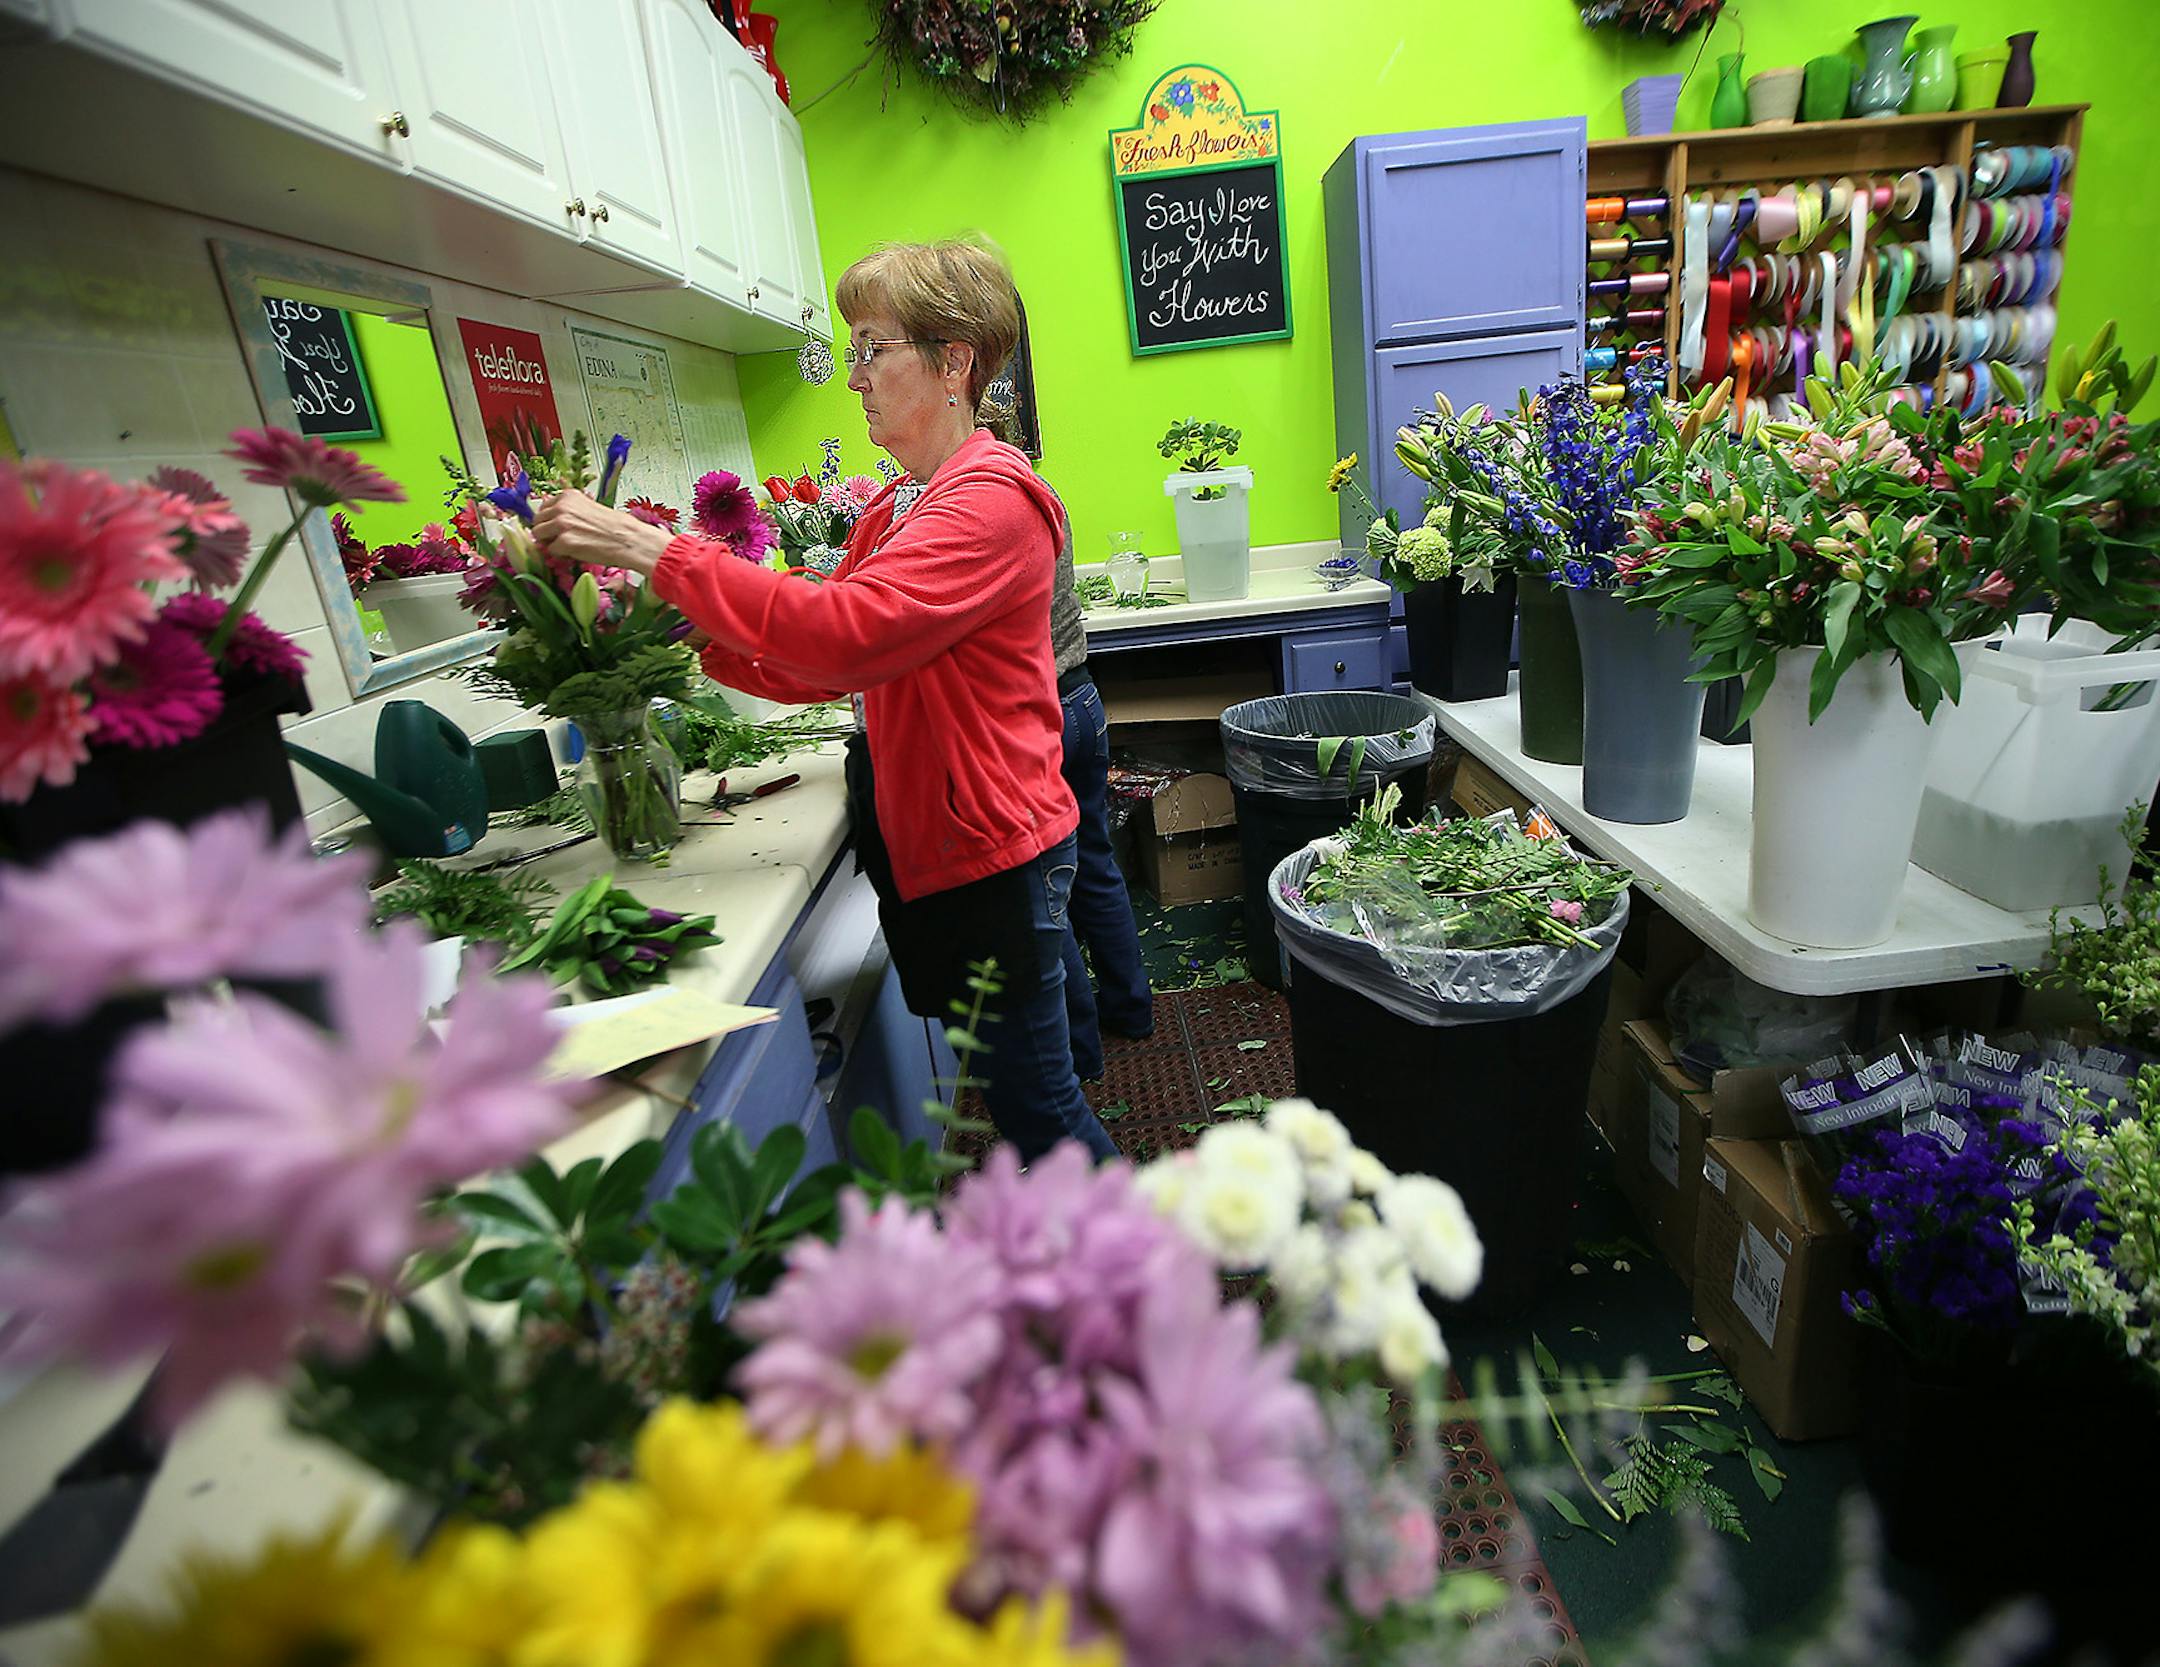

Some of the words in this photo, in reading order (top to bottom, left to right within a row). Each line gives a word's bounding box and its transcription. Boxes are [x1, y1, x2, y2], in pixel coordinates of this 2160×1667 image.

[1120, 134, 1186, 165] Fresh
[1145, 192, 1205, 242] Say
[1229, 188, 1271, 224] Love
[1183, 224, 1269, 278] With
[1149, 279, 1269, 328] Flowers
[474, 343, 545, 385] teleflora
[585, 355, 619, 379] EDINA
[1853, 1051, 1904, 1093] NEW
[1960, 1036, 2021, 1073] NEW
[1963, 1069, 1994, 1089] New
[1815, 1113, 1845, 1130] New
